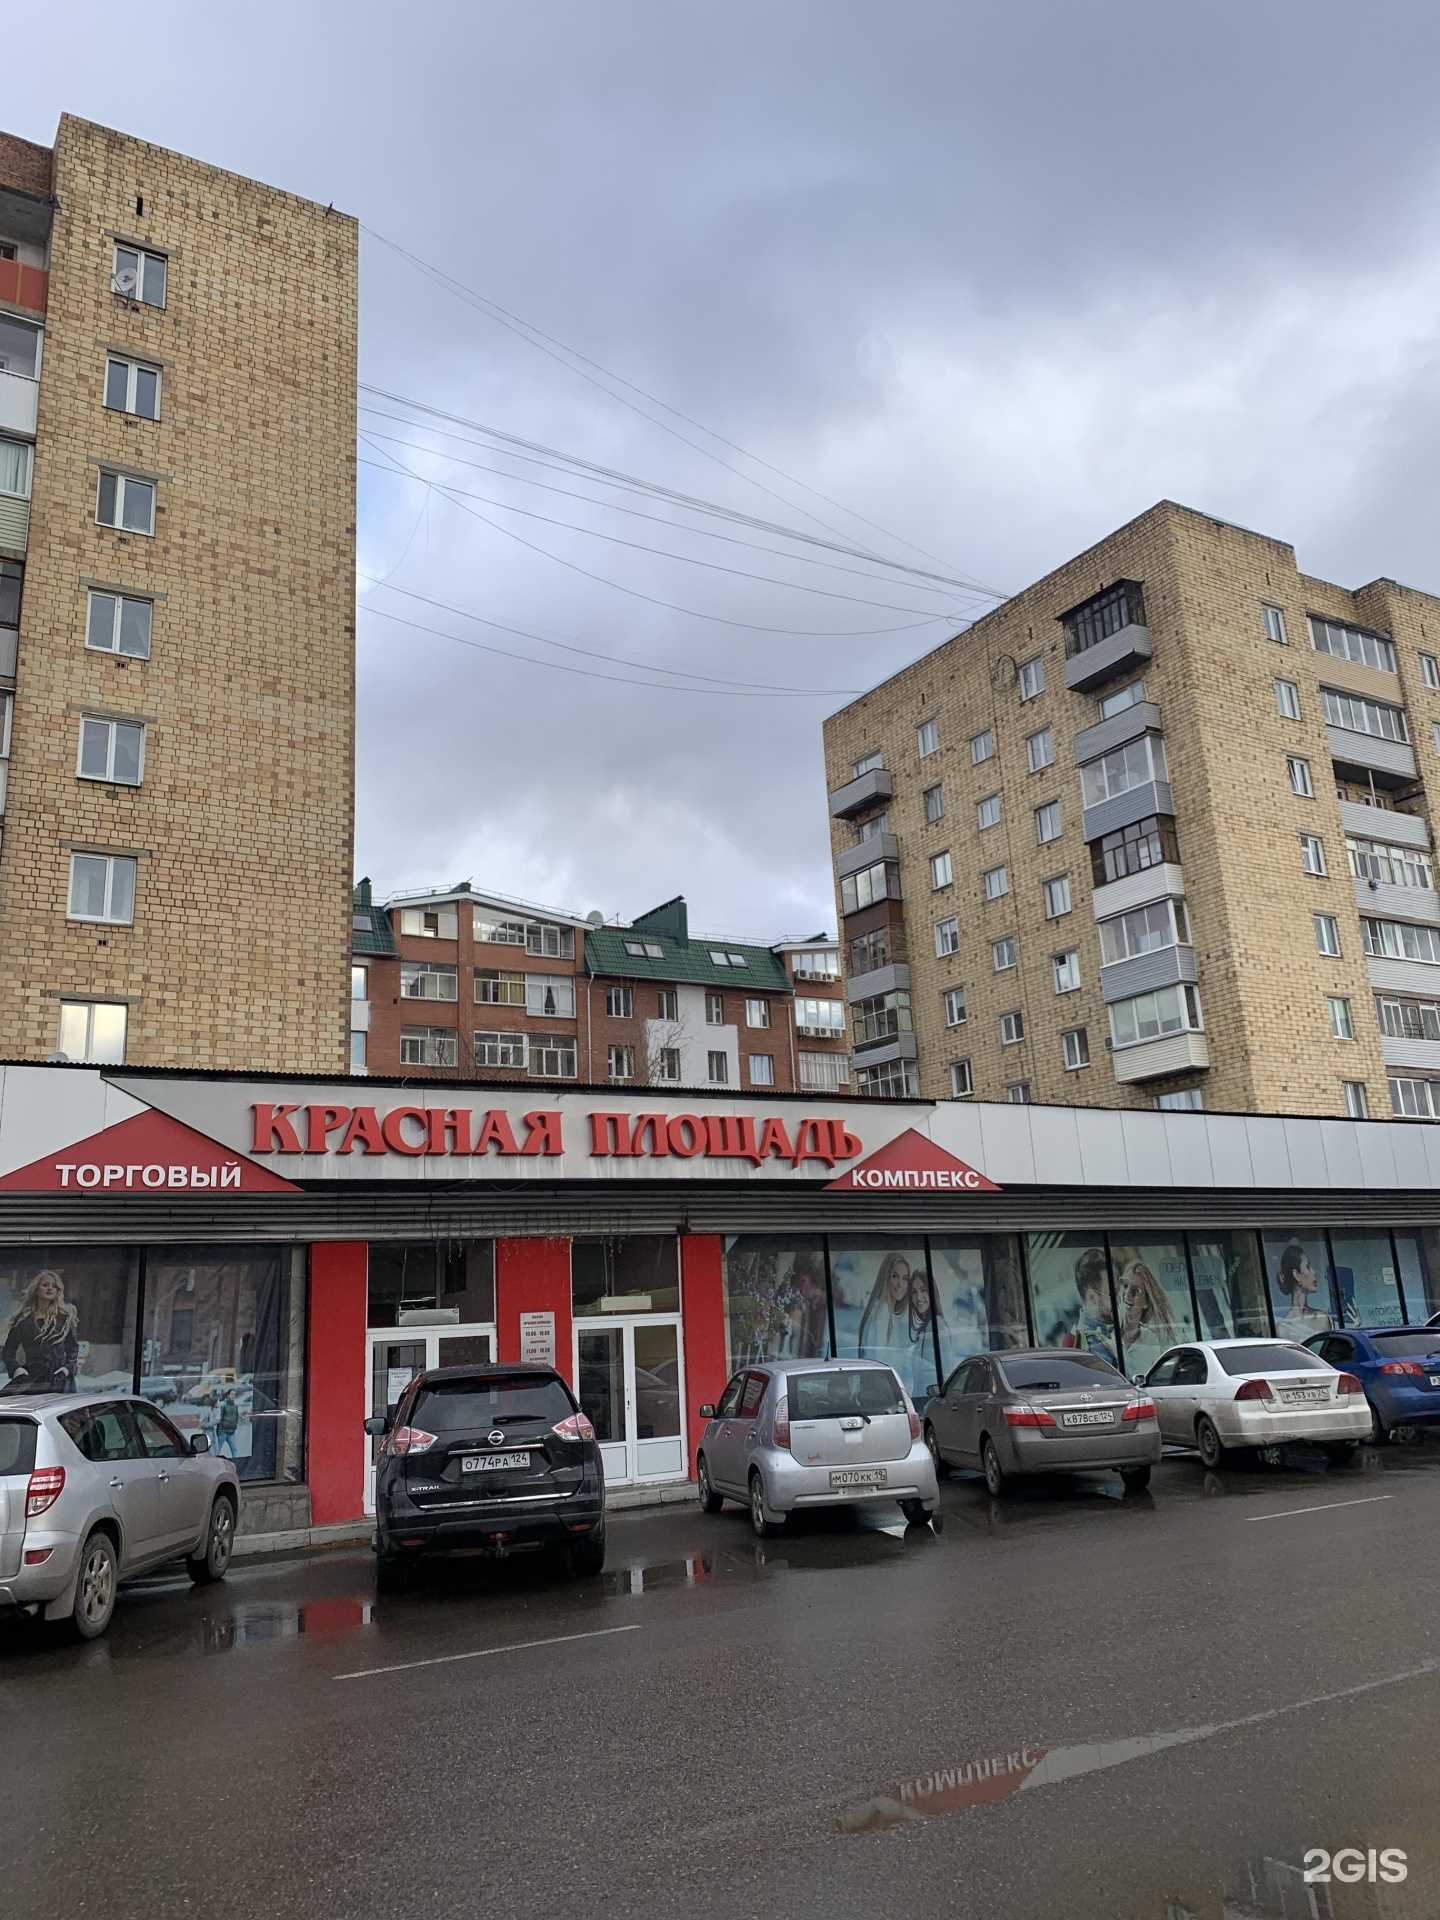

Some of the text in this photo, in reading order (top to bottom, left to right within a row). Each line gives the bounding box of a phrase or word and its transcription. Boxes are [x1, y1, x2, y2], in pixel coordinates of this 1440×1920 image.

[249, 1103, 863, 1168] КРАСНАЯ ПЛОЩАДЬ
[56, 1161, 242, 1188] ТОРГОВЫЙ
[852, 1168, 981, 1189] КОМПЛЕКС
[510, 1453, 527, 1463] 124
